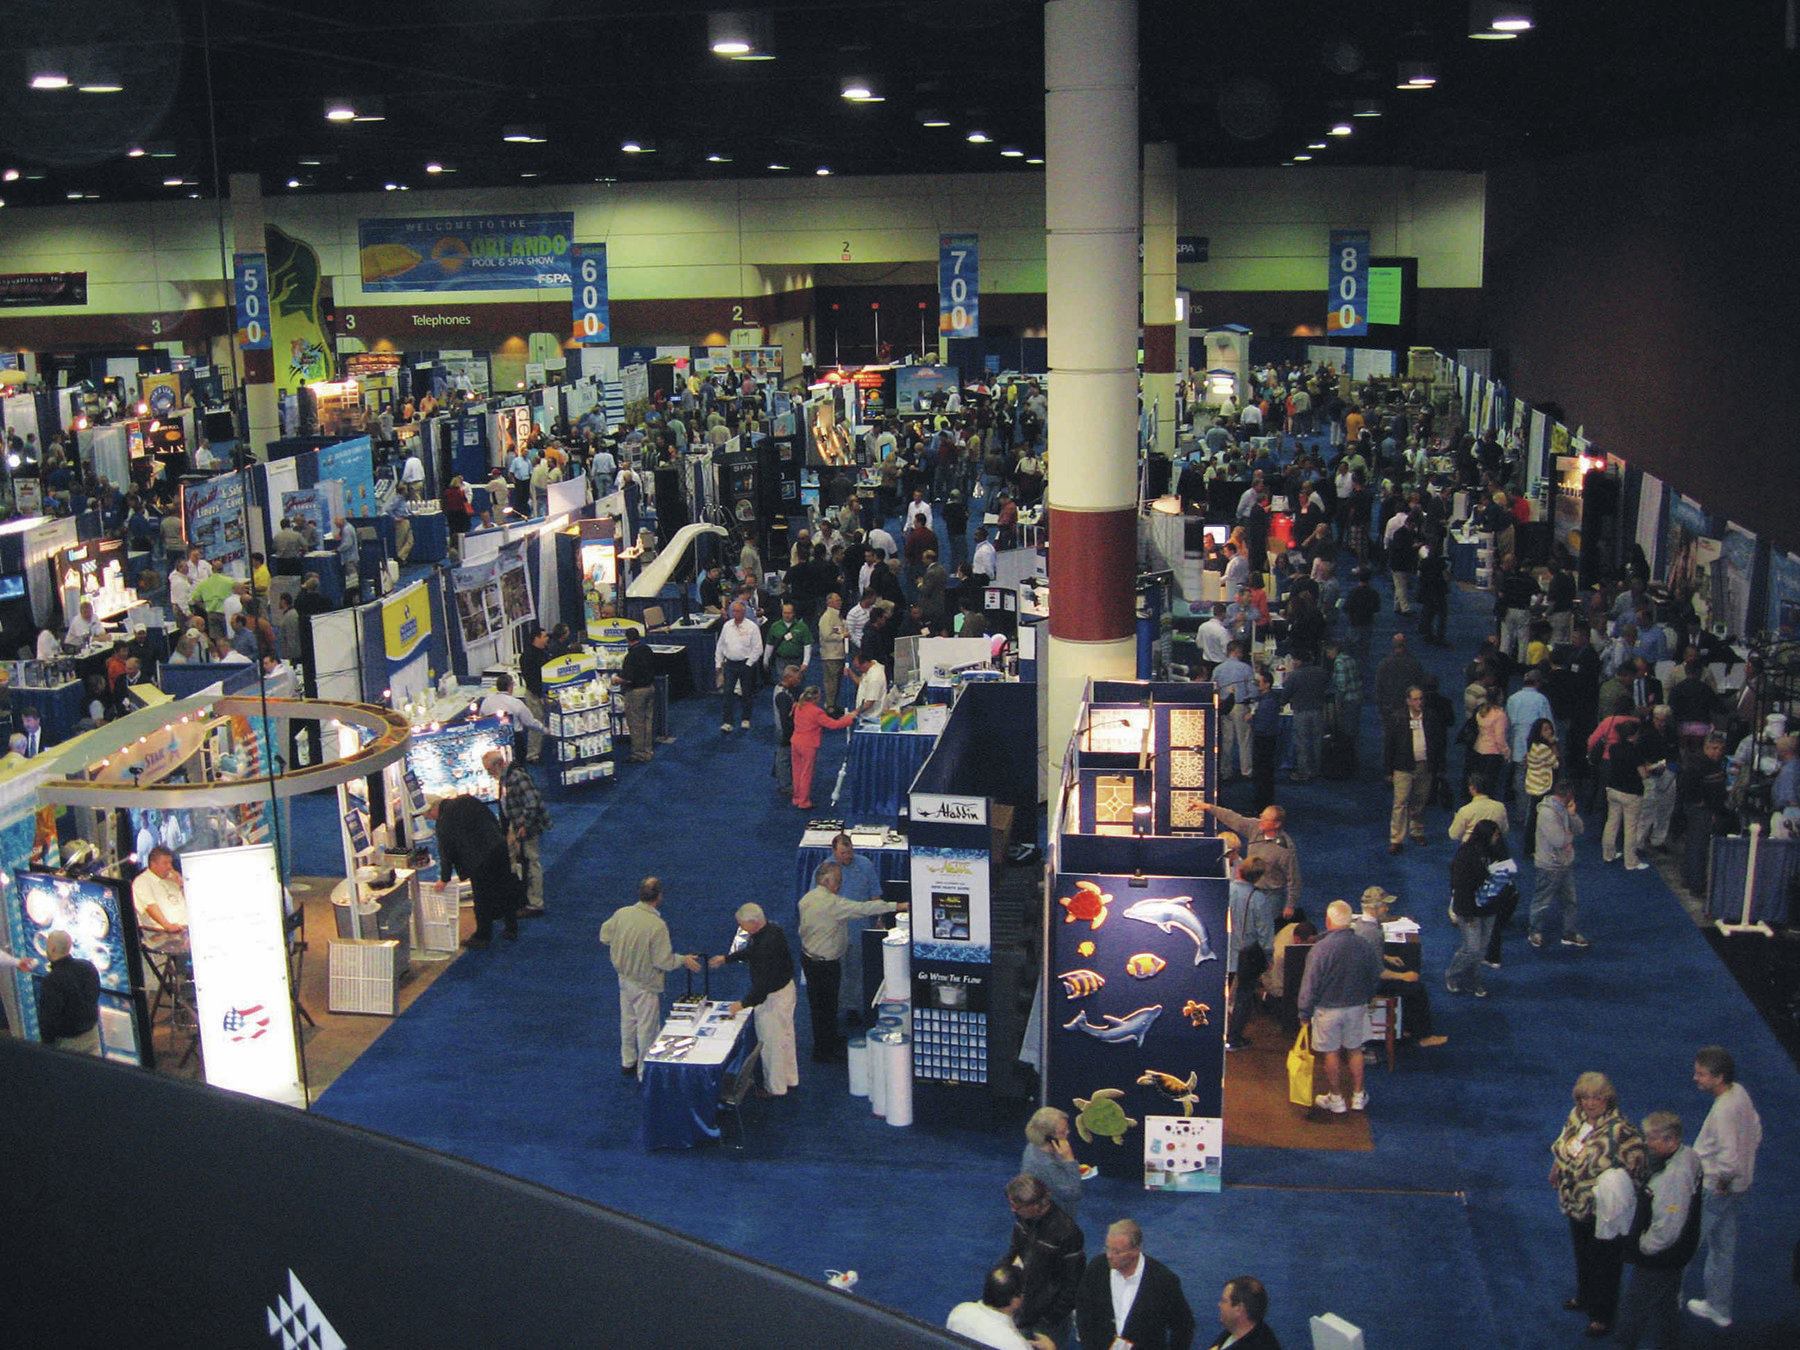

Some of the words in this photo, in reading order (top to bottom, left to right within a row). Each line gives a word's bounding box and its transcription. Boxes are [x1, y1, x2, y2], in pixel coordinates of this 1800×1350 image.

[406, 220, 473, 231] WELCOME
[480, 221, 495, 230] TO
[501, 219, 527, 228] THE
[471, 233, 567, 257] ORLANDO
[842, 242, 850, 253] 2
[472, 258, 497, 267] POOL
[498, 257, 505, 266] &
[508, 257, 524, 267] SPA
[525, 256, 554, 266] SHOW
[537, 273, 572, 284] FSPA
[950, 251, 968, 330] 700
[1340, 247, 1357, 329] 800
[581, 259, 599, 336] 600
[244, 268, 262, 343] 500
[732, 305, 743, 322] 2
[152, 320, 161, 335] 3
[346, 314, 356, 329] 3
[411, 315, 471, 328] Telephones
[733, 464, 754, 473] SPA
[934, 801, 979, 820] Aladdin
